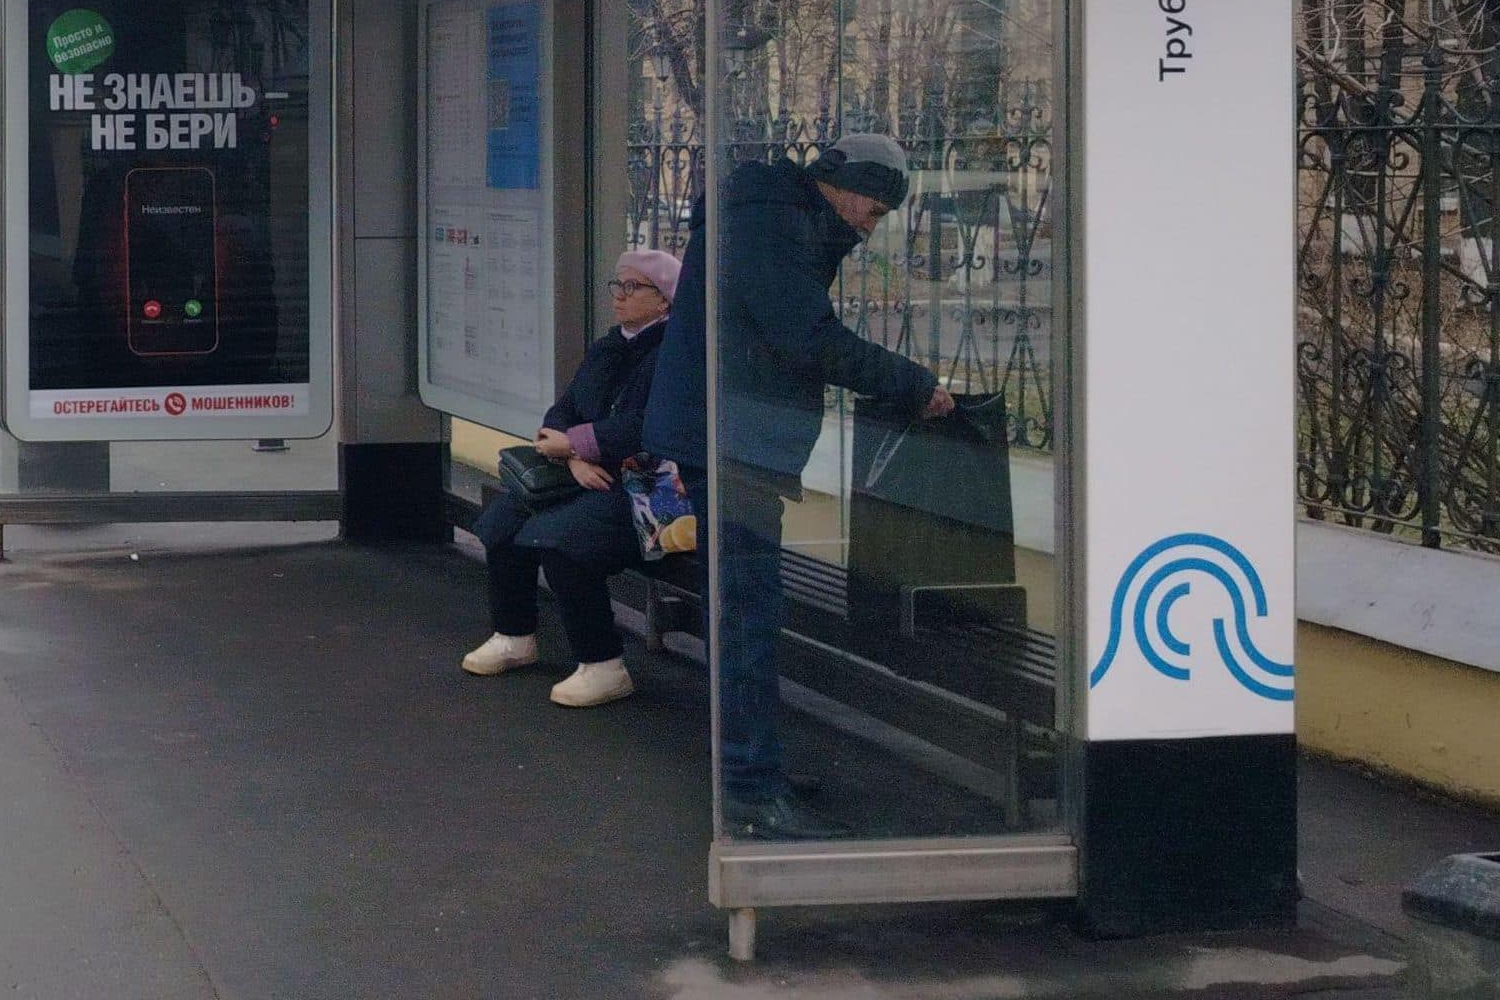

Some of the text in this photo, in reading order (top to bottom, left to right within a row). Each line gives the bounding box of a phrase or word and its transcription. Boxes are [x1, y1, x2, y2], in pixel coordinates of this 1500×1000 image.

[52, 23, 104, 49] Просто и
[53, 35, 113, 64] безопасно
[50, 73, 96, 111] НЕ
[103, 72, 256, 111] ЗНАЕШЬ
[91, 112, 237, 150] НЕ БЕРИ
[53, 395, 295, 415] ОСТЕРЕГАЙТЕСЬ МОШЕННИКОВ!
